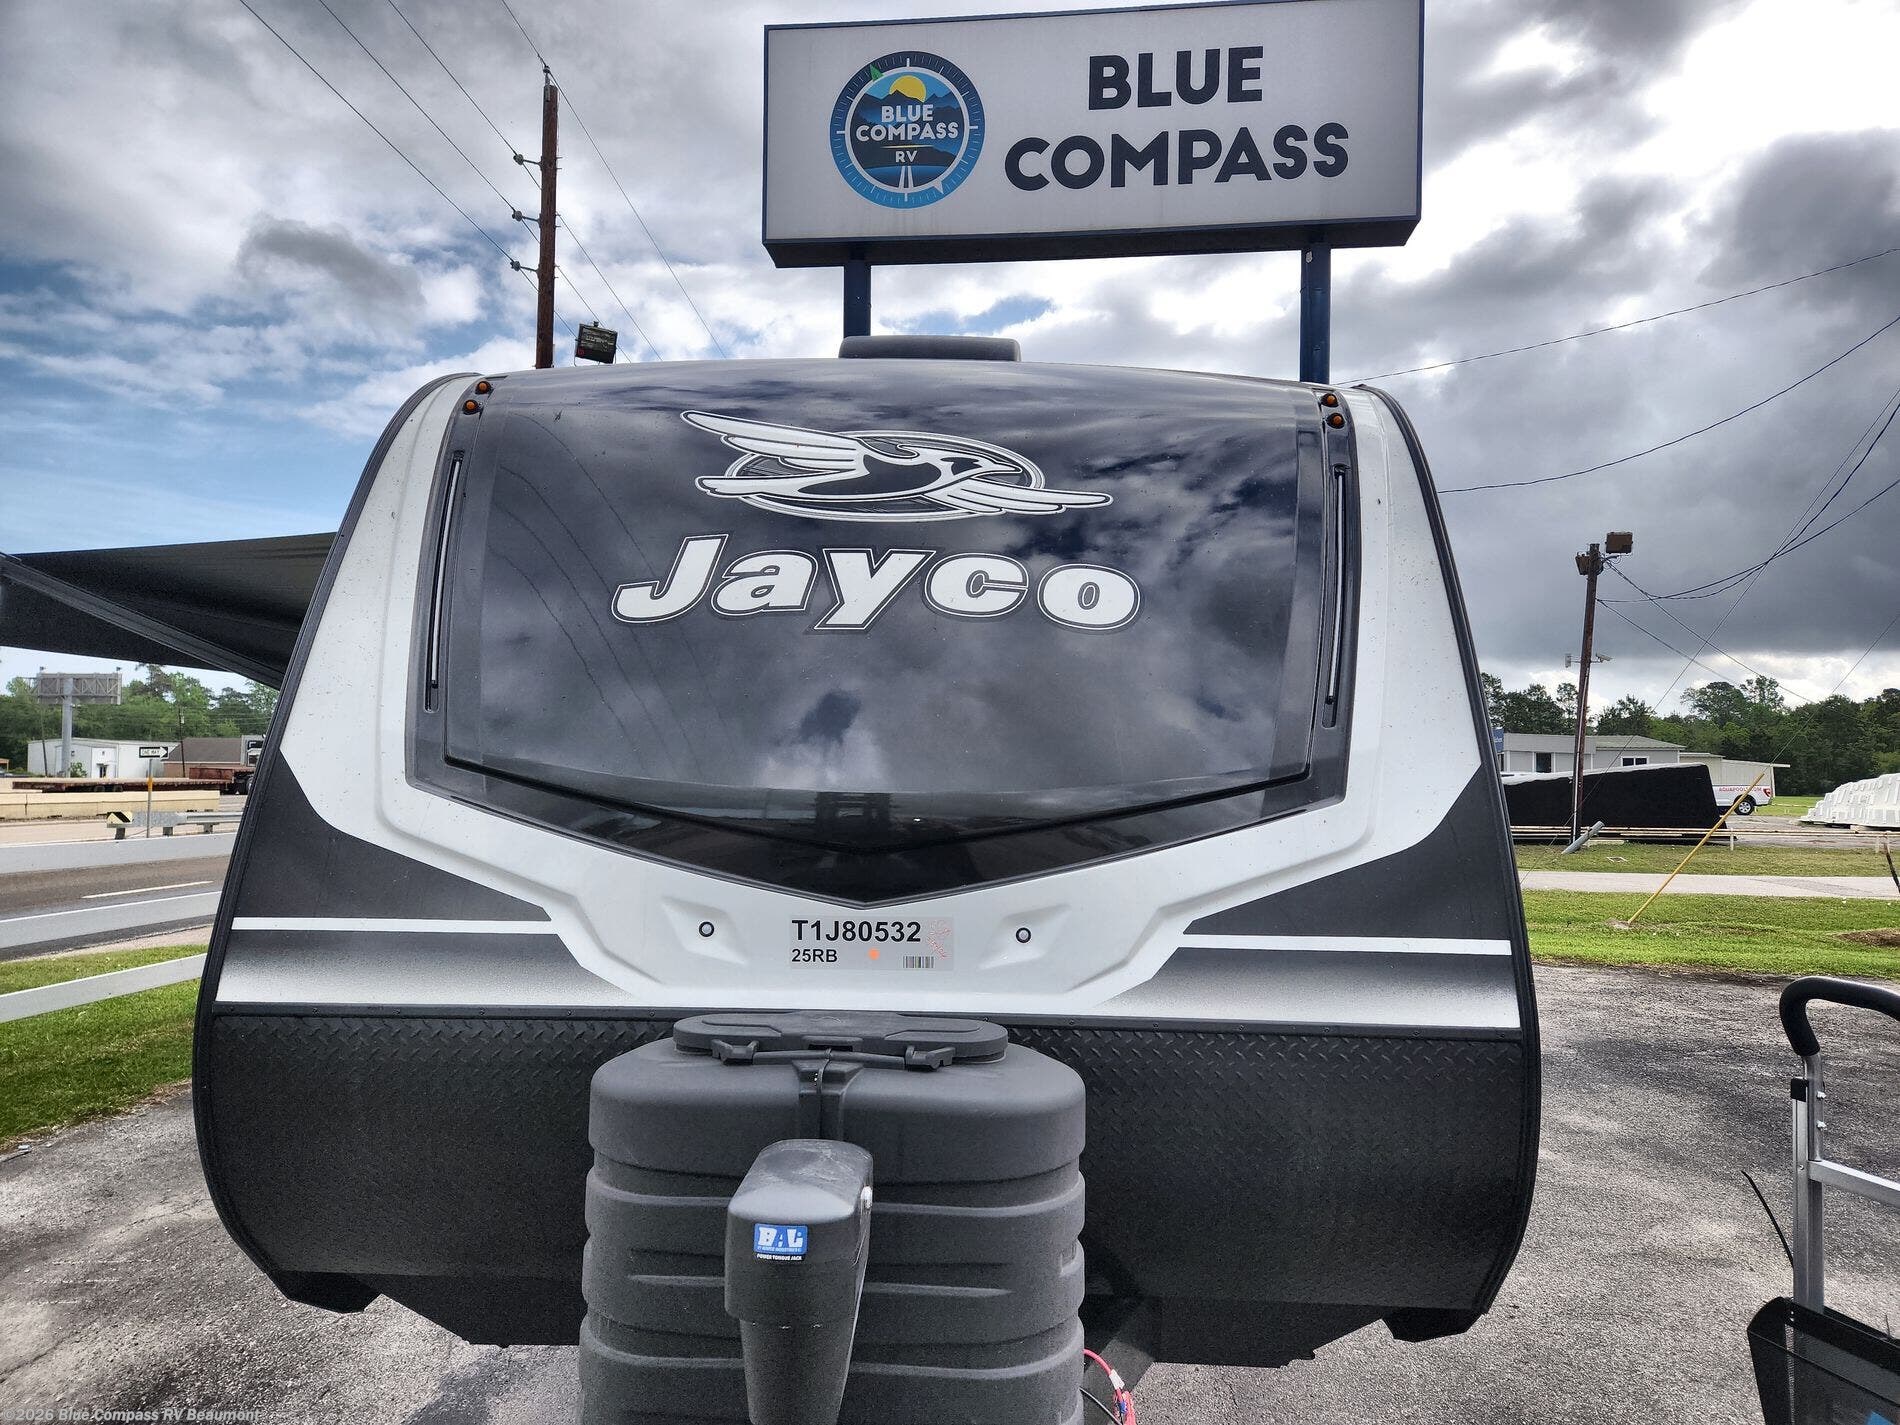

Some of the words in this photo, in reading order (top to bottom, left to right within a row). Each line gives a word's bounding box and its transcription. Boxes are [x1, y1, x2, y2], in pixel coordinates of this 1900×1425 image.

[1088, 45, 1264, 110] BLUE
[881, 104, 934, 123] BLUE
[856, 122, 959, 142] COMPASS
[895, 151, 918, 163] RV
[1005, 122, 1349, 191] COMPASS
[611, 534, 1141, 631] Jayco
[791, 920, 921, 942] T1J80532
[791, 949, 838, 963] 25RB
[758, 1227, 803, 1248] BAL
